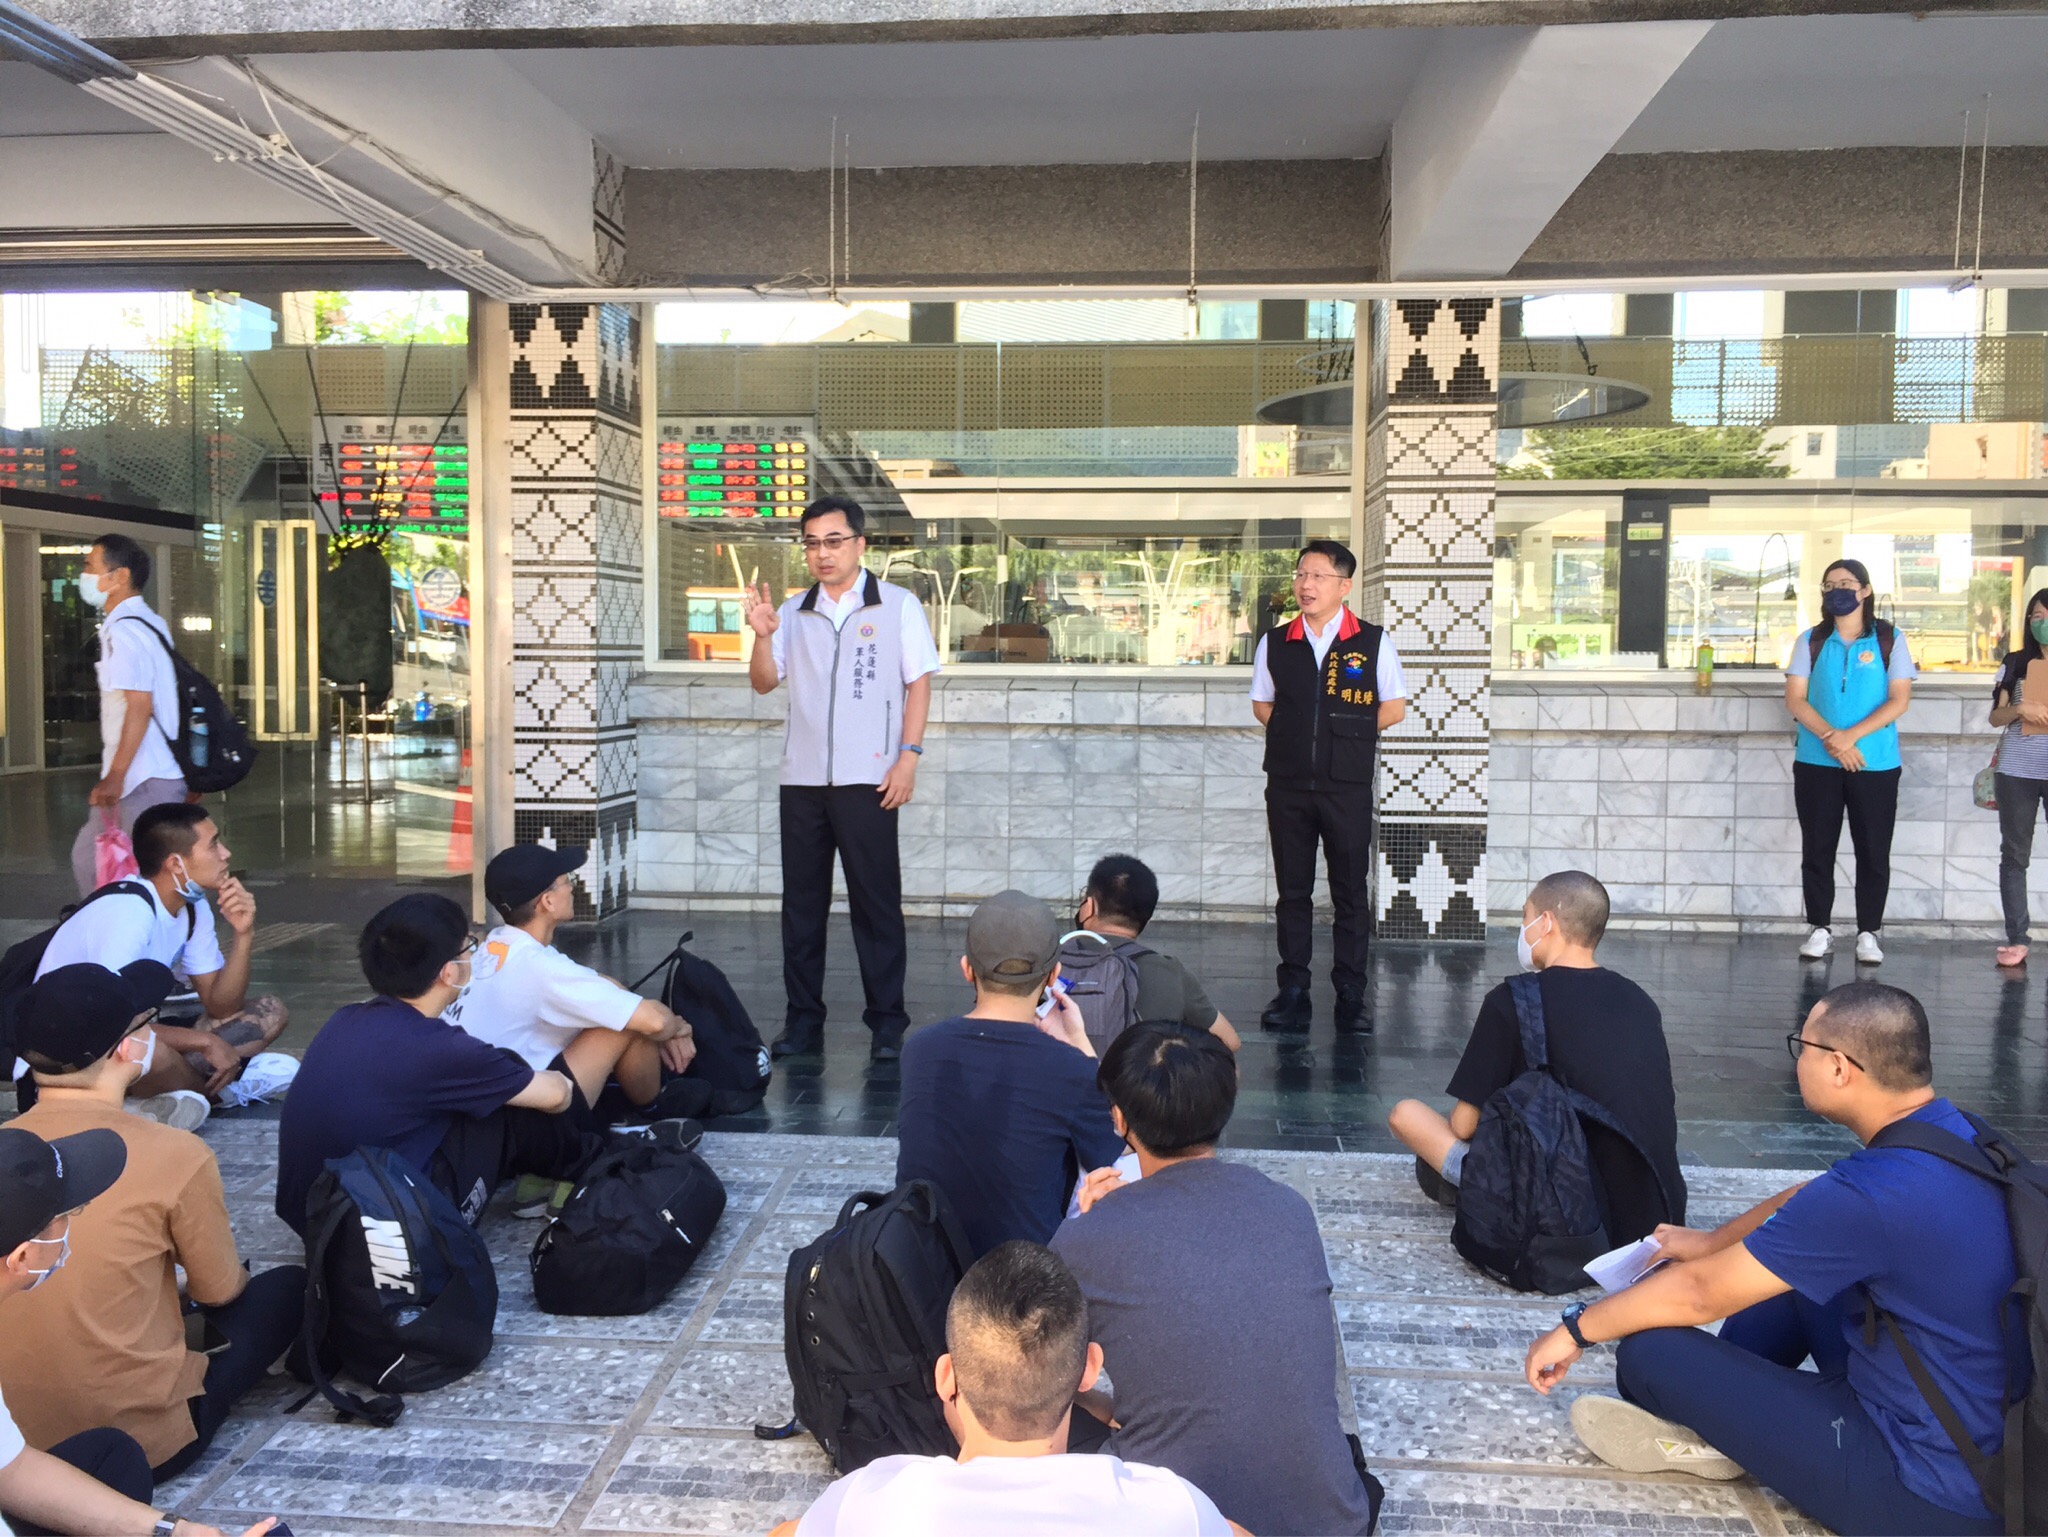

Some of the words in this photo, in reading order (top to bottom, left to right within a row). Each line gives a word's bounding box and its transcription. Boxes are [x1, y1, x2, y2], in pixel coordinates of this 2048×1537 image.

[853, 647, 865, 700] 軍人服務站
[866, 643, 878, 681] 花蓮縣
[360, 1215, 416, 1295] NIKE
